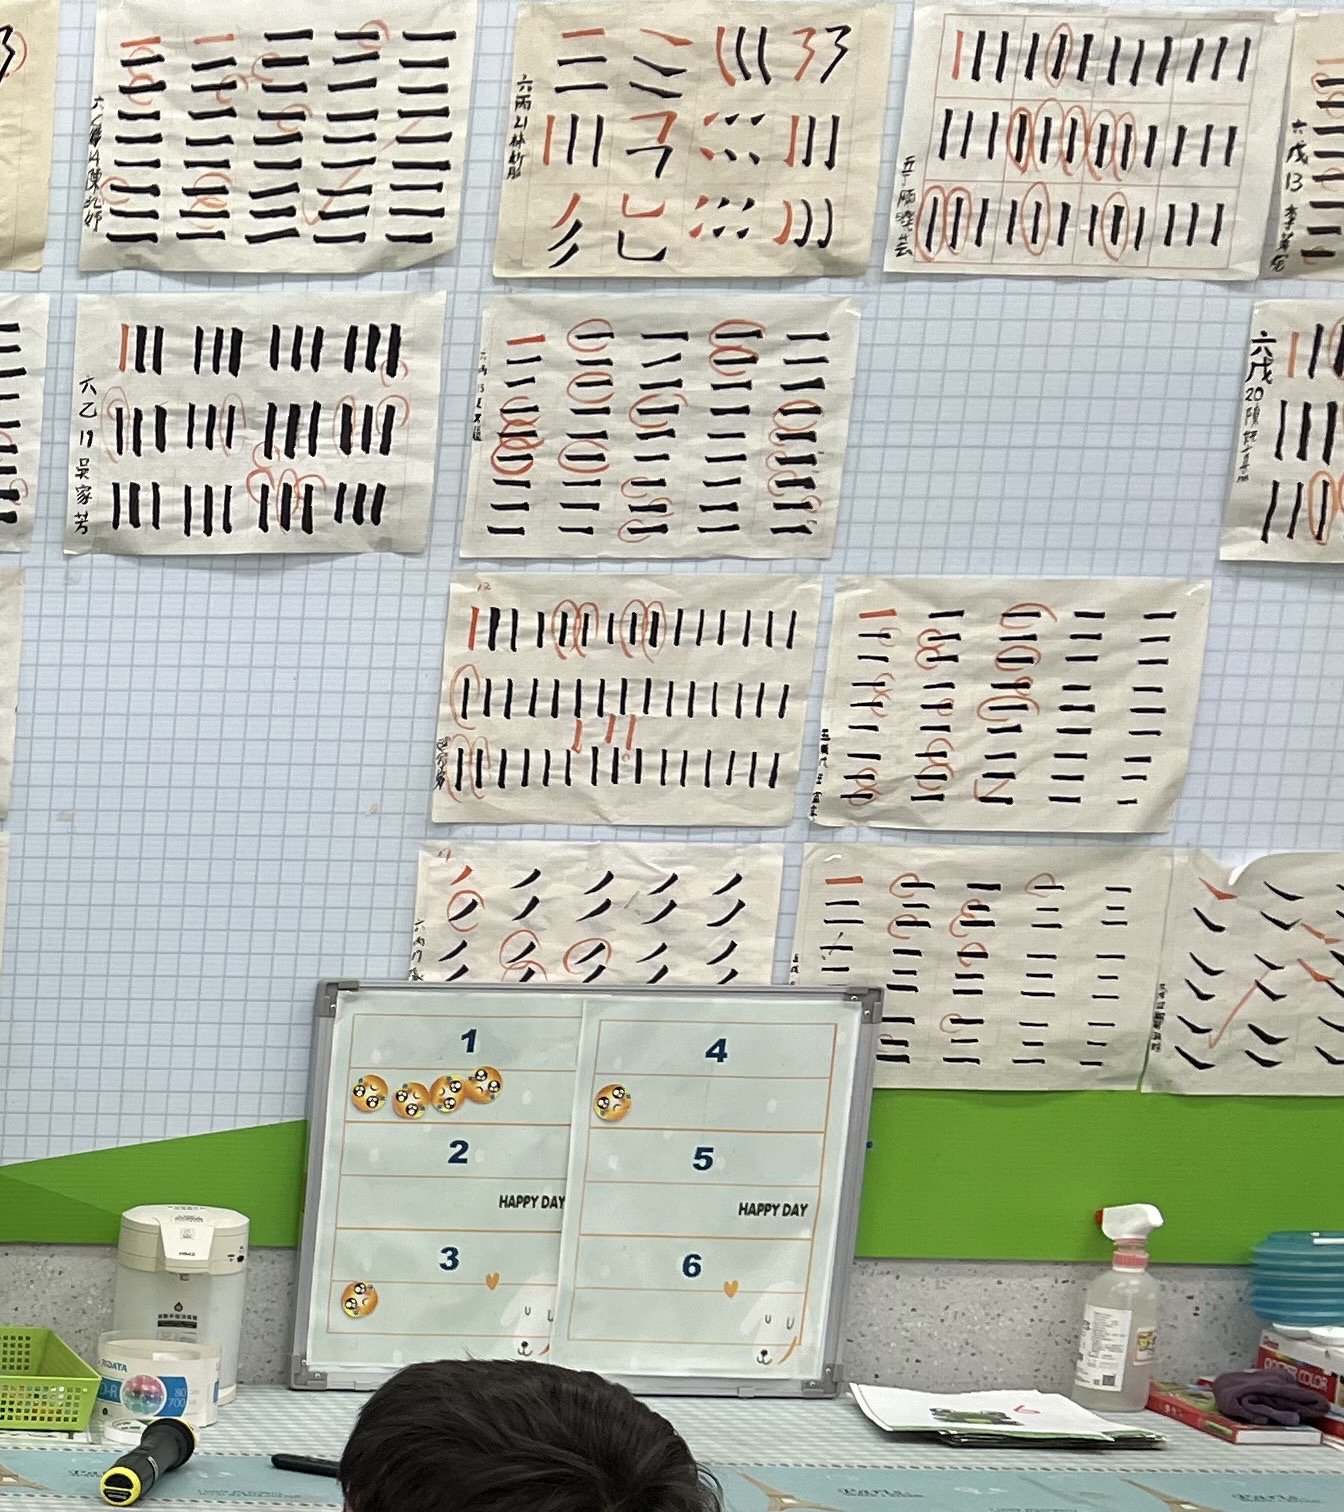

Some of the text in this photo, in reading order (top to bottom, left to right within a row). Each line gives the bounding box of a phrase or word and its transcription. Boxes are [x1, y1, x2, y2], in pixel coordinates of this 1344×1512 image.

[460, 1028, 479, 1054] 1
[704, 1037, 728, 1063] 4
[447, 1139, 470, 1165] 2
[692, 1146, 715, 1172] 5
[499, 1194, 566, 1210] HAPPY DAY
[738, 1201, 809, 1218] HAPPY DAY
[438, 1246, 461, 1272] 3
[681, 1253, 703, 1279] 6
